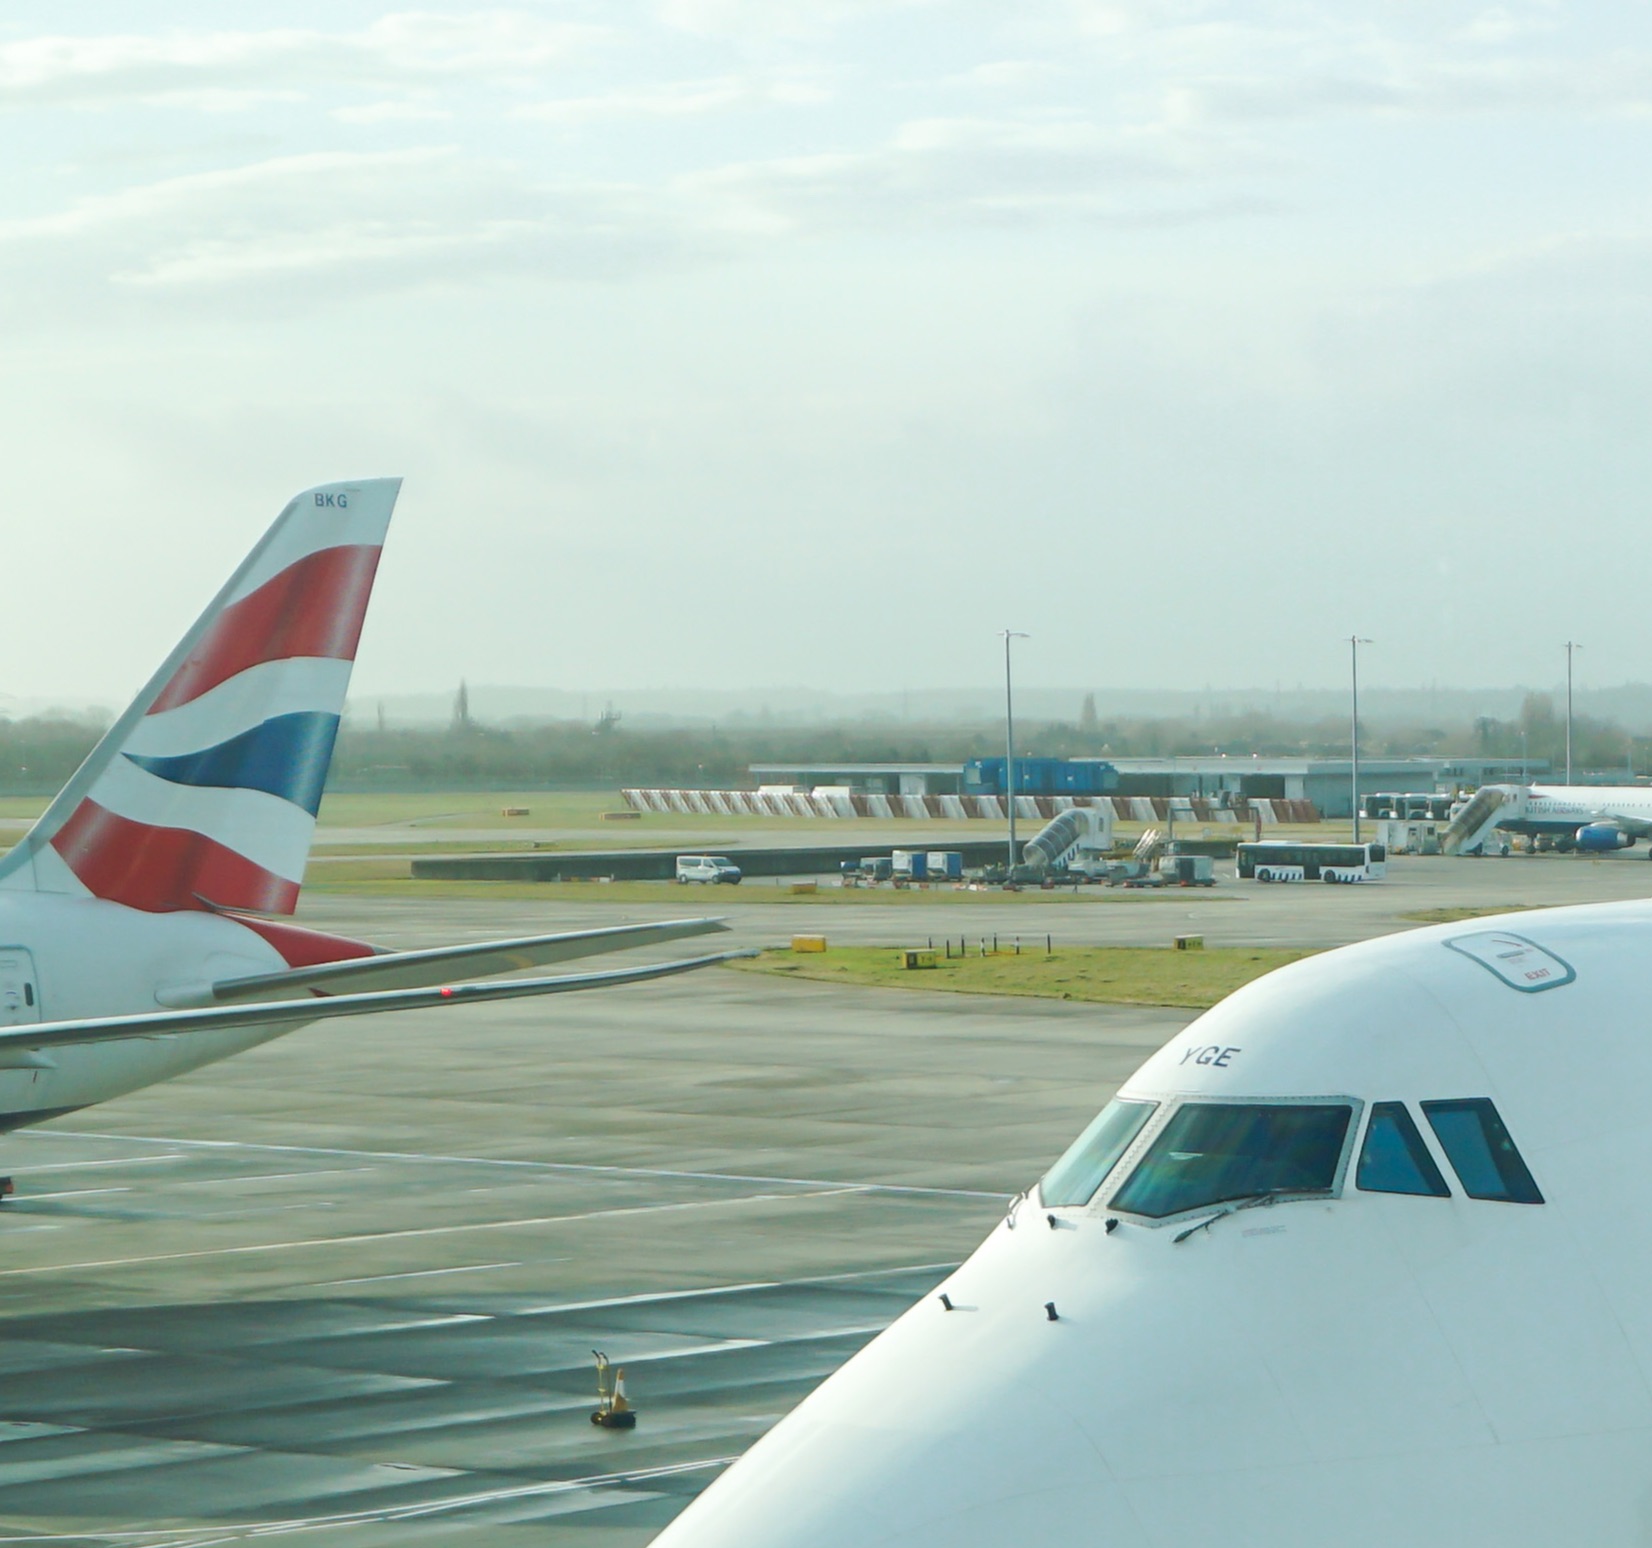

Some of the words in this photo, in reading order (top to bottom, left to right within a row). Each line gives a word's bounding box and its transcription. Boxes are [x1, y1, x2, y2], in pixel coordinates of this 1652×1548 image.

[315, 493, 347, 508] BKG
[1524, 968, 1551, 981] EXIT
[1179, 1046, 1242, 1068] YGE
